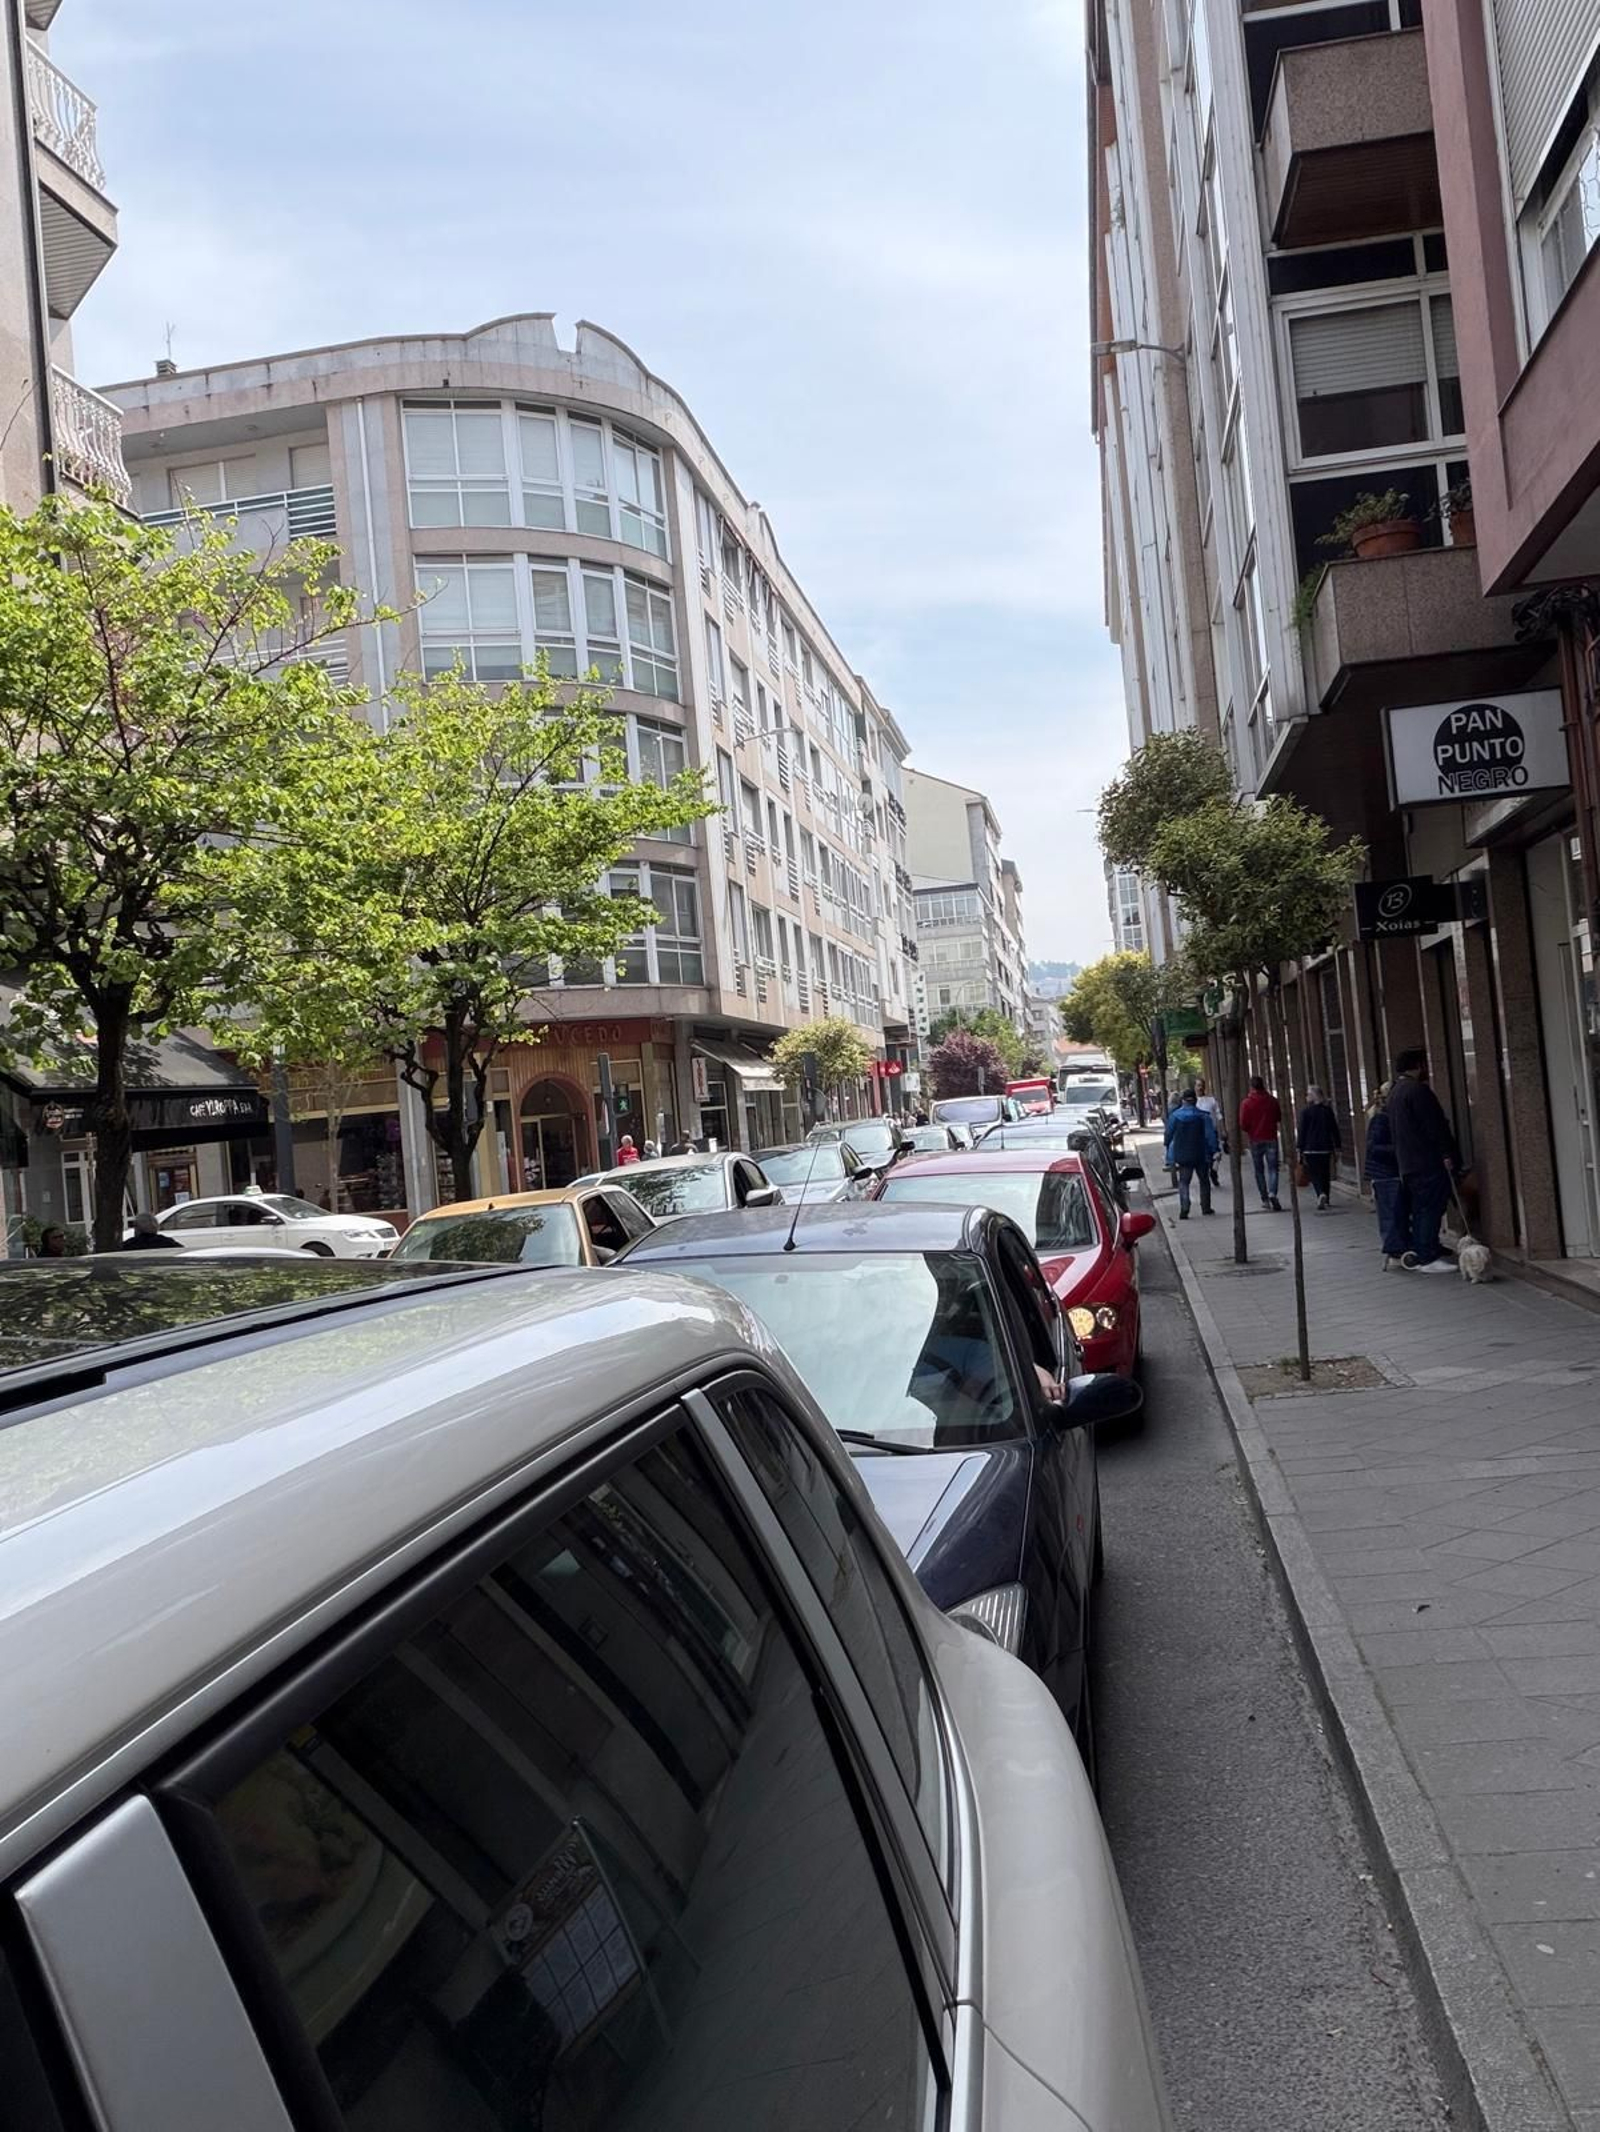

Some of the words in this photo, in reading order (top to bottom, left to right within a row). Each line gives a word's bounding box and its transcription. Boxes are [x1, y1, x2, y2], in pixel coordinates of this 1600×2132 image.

[1450, 708, 1503, 735] PAN
[1437, 736, 1523, 766] PUNTO
[1438, 765, 1529, 795] NEGRO
